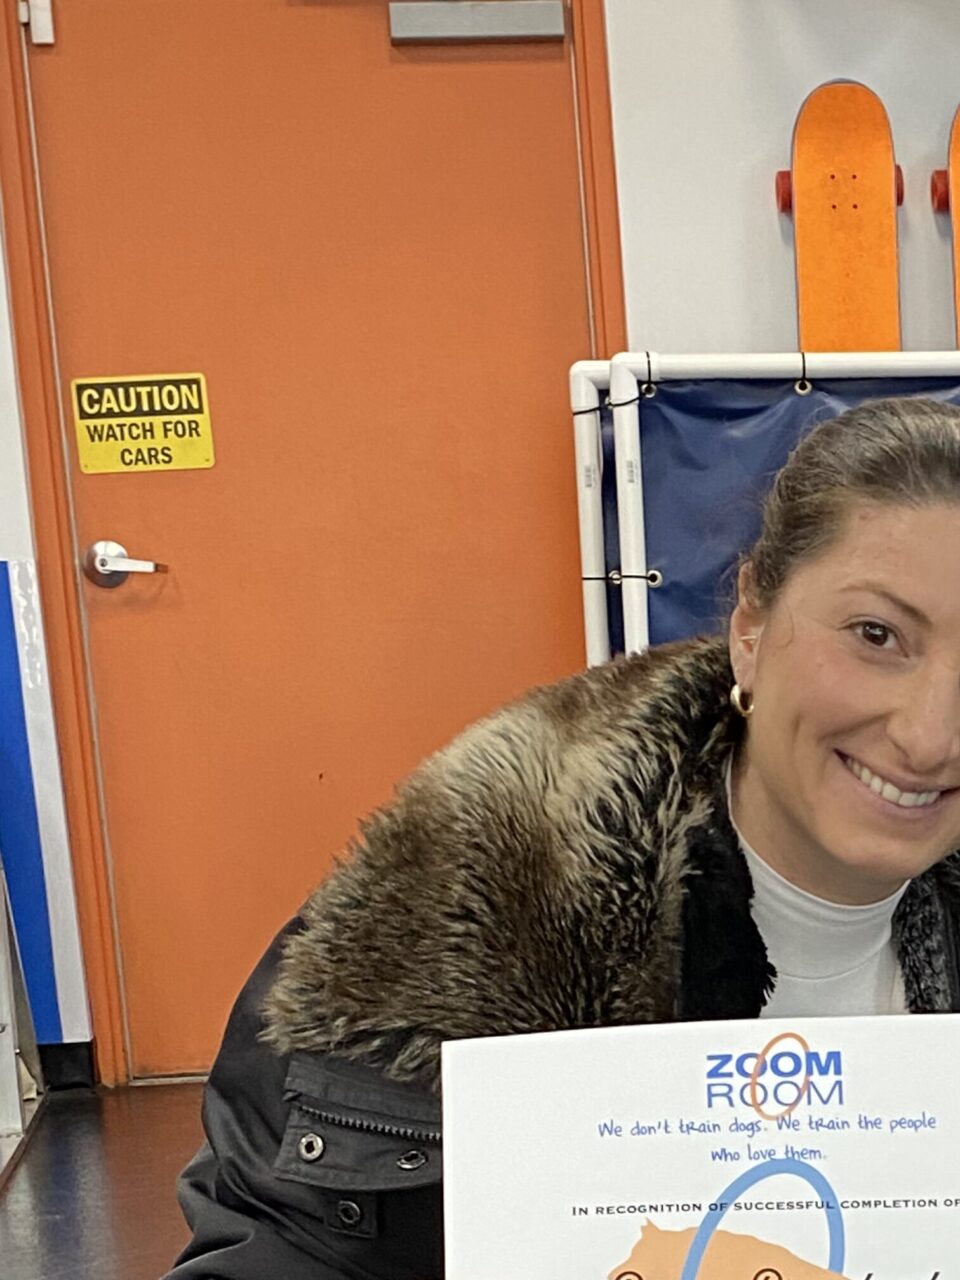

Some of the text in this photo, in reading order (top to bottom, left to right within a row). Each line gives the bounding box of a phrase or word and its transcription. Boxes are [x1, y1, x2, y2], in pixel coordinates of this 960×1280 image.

[81, 384, 200, 414] CAUTION
[86, 419, 201, 443] WATCH FOR
[120, 446, 173, 466] CARS
[706, 1051, 842, 1079] ZOOM
[707, 1080, 844, 1108] ROOM
[598, 1119, 622, 1137] We
[630, 1119, 671, 1136] don't
[729, 1117, 768, 1138] dogs.
[776, 1112, 800, 1131] We
[857, 1113, 882, 1129] the
[890, 1112, 936, 1133] people
[747, 1144, 776, 1160] love
[785, 1144, 827, 1160] them.
[572, 1206, 588, 1216] IN
[596, 1203, 702, 1216] RECOGNITION
[708, 1203, 728, 1212] OF
[734, 1201, 836, 1211] SUCCESSFUL
[840, 1199, 938, 1209] COMPLETION
